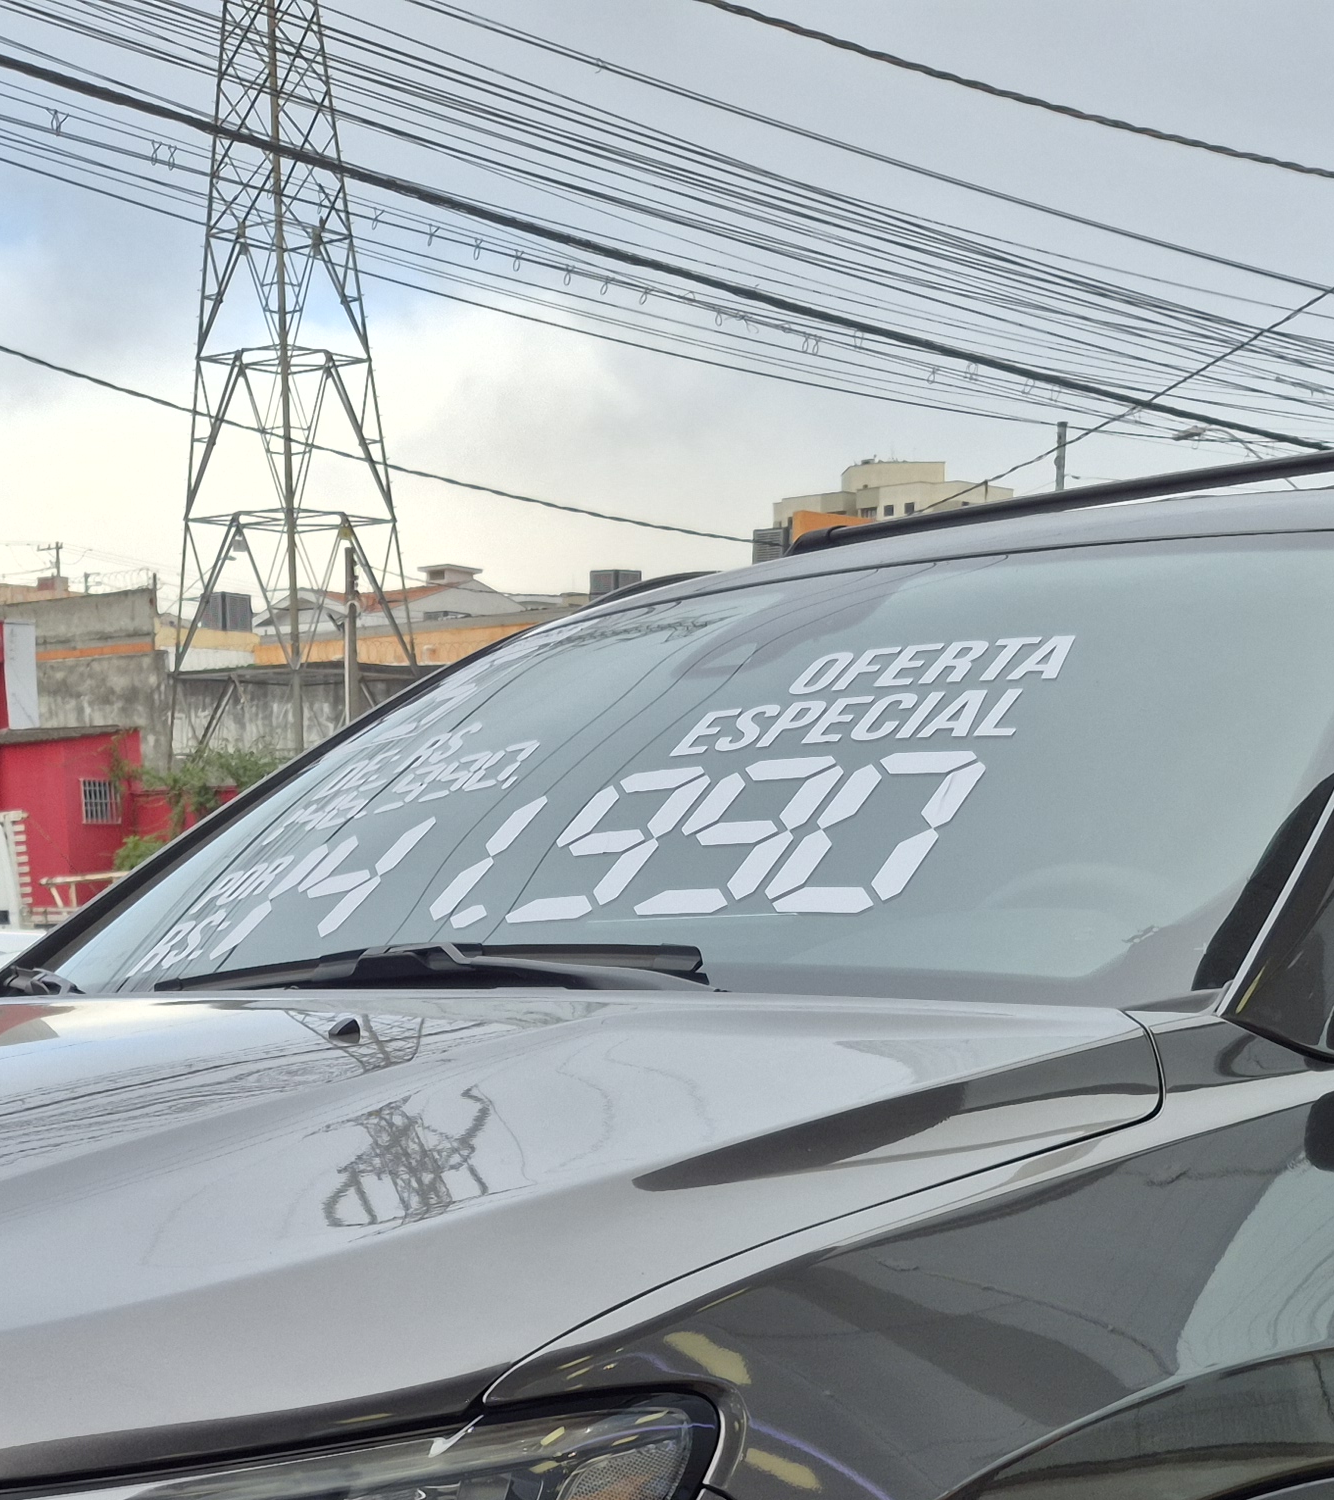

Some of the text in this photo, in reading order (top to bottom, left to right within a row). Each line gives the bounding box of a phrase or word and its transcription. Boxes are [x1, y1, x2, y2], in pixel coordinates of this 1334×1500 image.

[789, 635, 1076, 695] OFERTA
[669, 688, 1024, 757] ESPECIAL
[190, 855, 295, 915] POR
